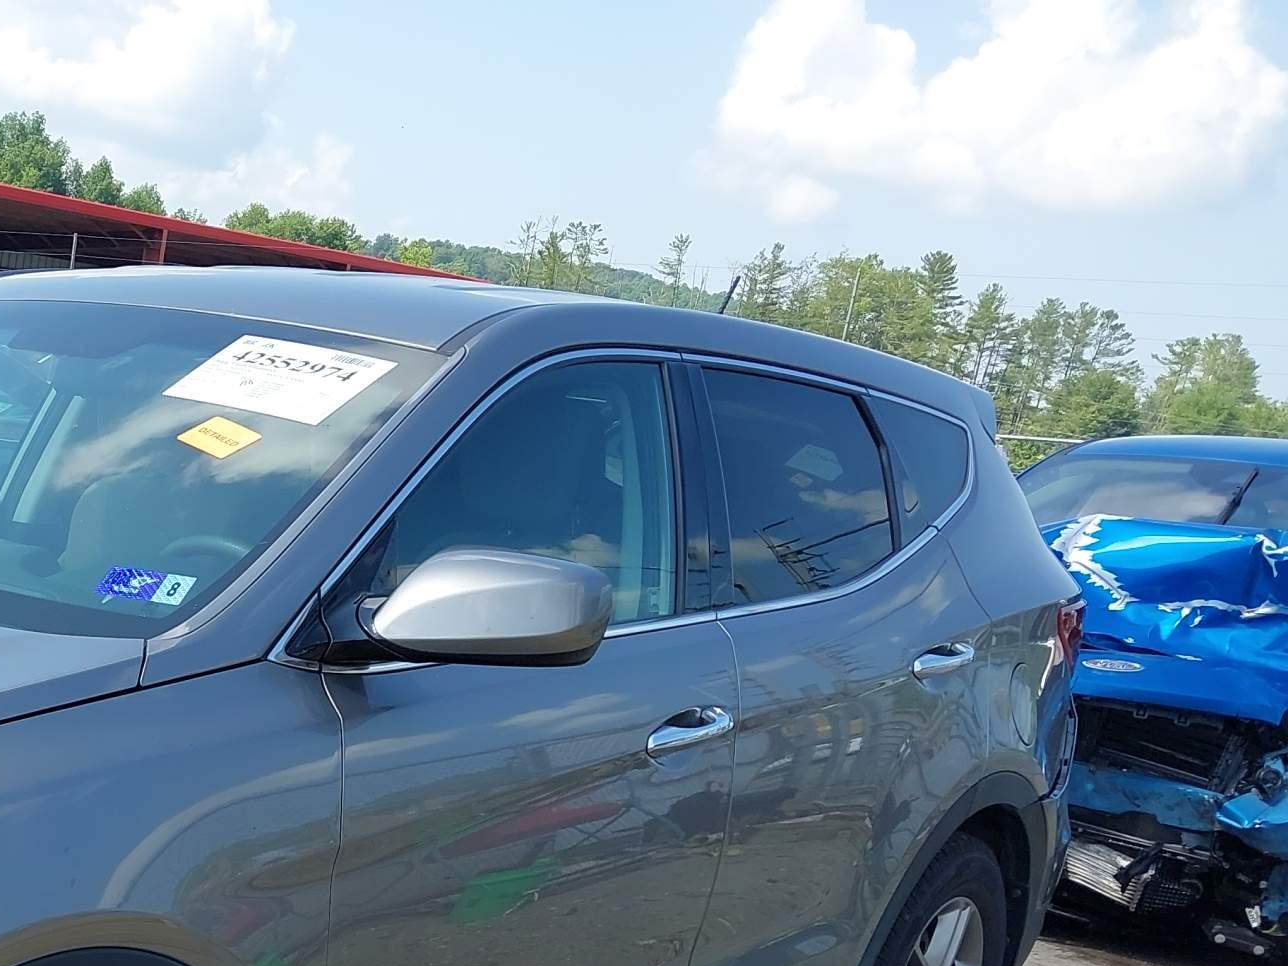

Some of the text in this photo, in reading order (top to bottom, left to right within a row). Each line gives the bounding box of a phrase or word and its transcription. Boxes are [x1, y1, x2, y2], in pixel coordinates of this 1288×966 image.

[232, 350, 359, 382] 42552974
[198, 427, 239, 448] DETAILED
[166, 582, 181, 597] 8
